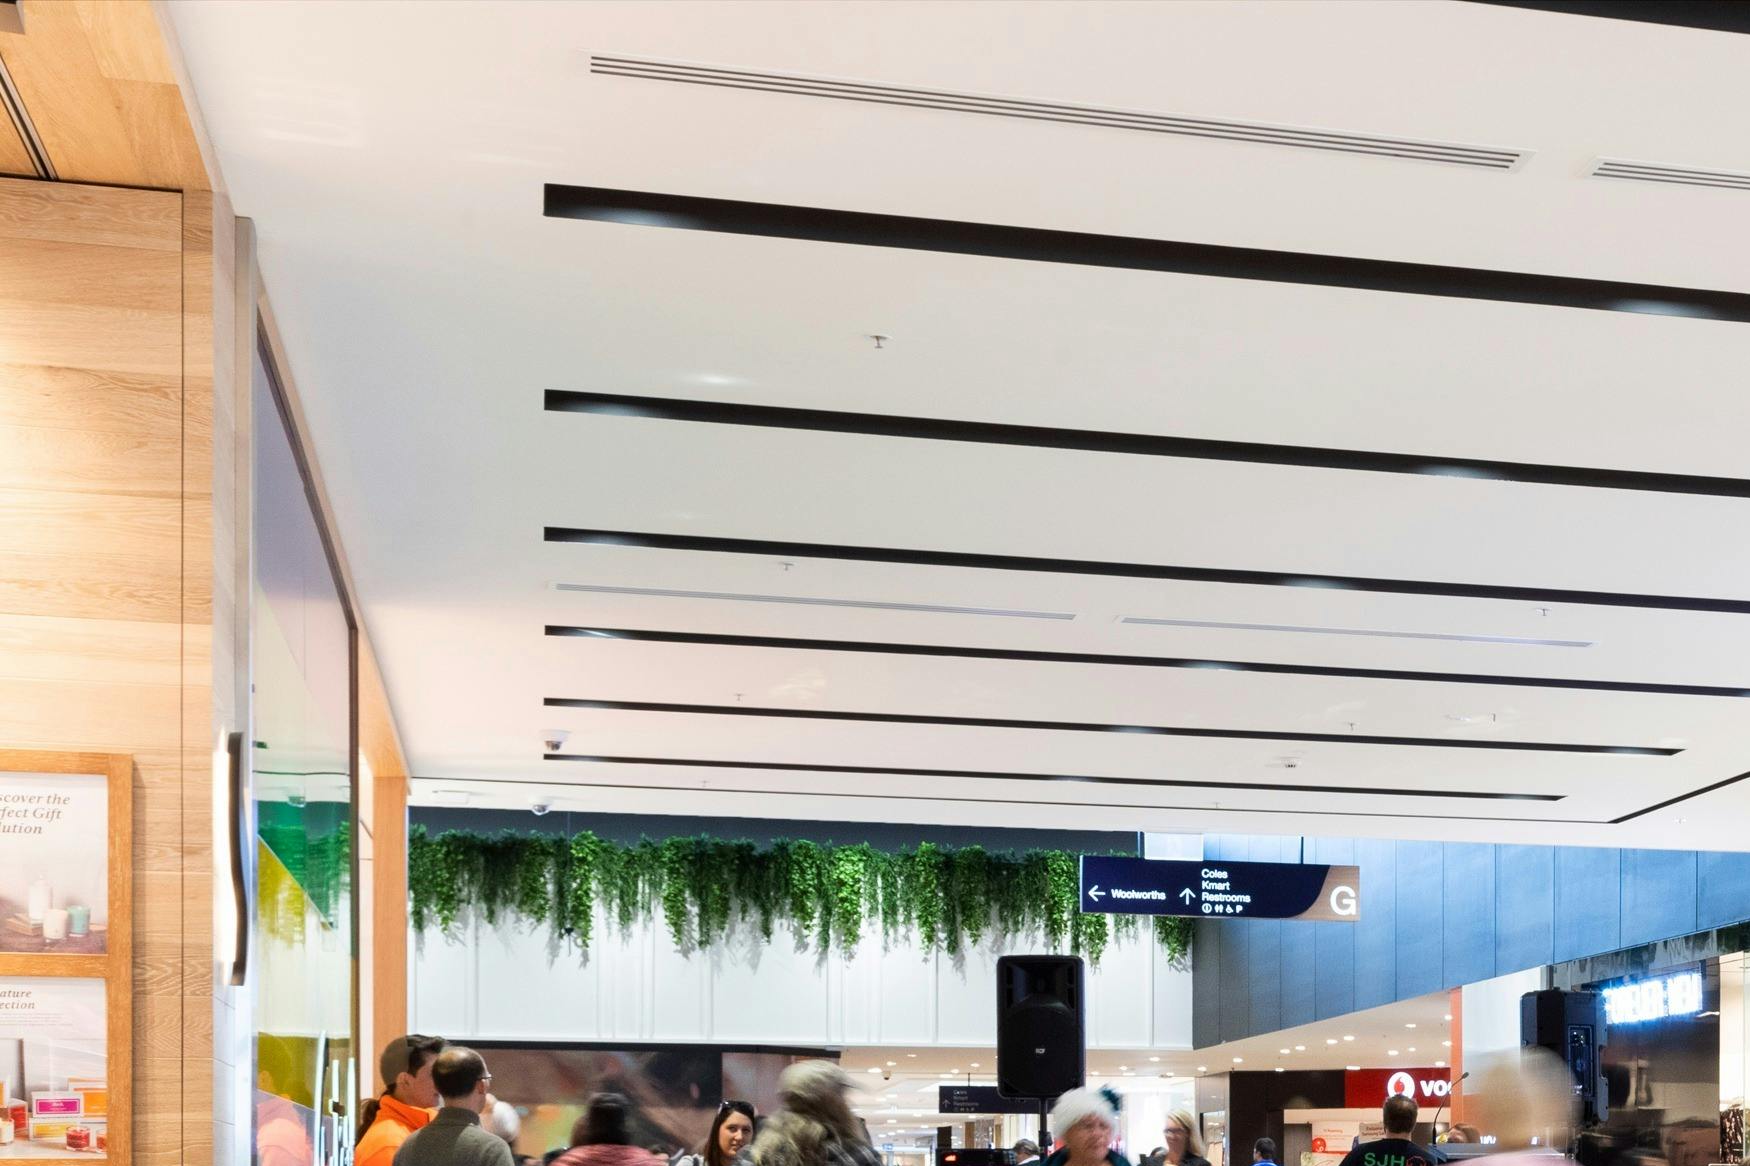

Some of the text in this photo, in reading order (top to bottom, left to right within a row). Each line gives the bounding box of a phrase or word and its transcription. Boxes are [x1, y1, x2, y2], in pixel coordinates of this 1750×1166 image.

[46, 792, 71, 805] the
[32, 807, 63, 822] Gift
[1201, 868, 1229, 879] Coles
[1201, 880, 1231, 891] Kmart
[1110, 888, 1167, 901] Woolworths
[1201, 891, 1252, 903] Restrooms
[1330, 885, 1357, 916] G
